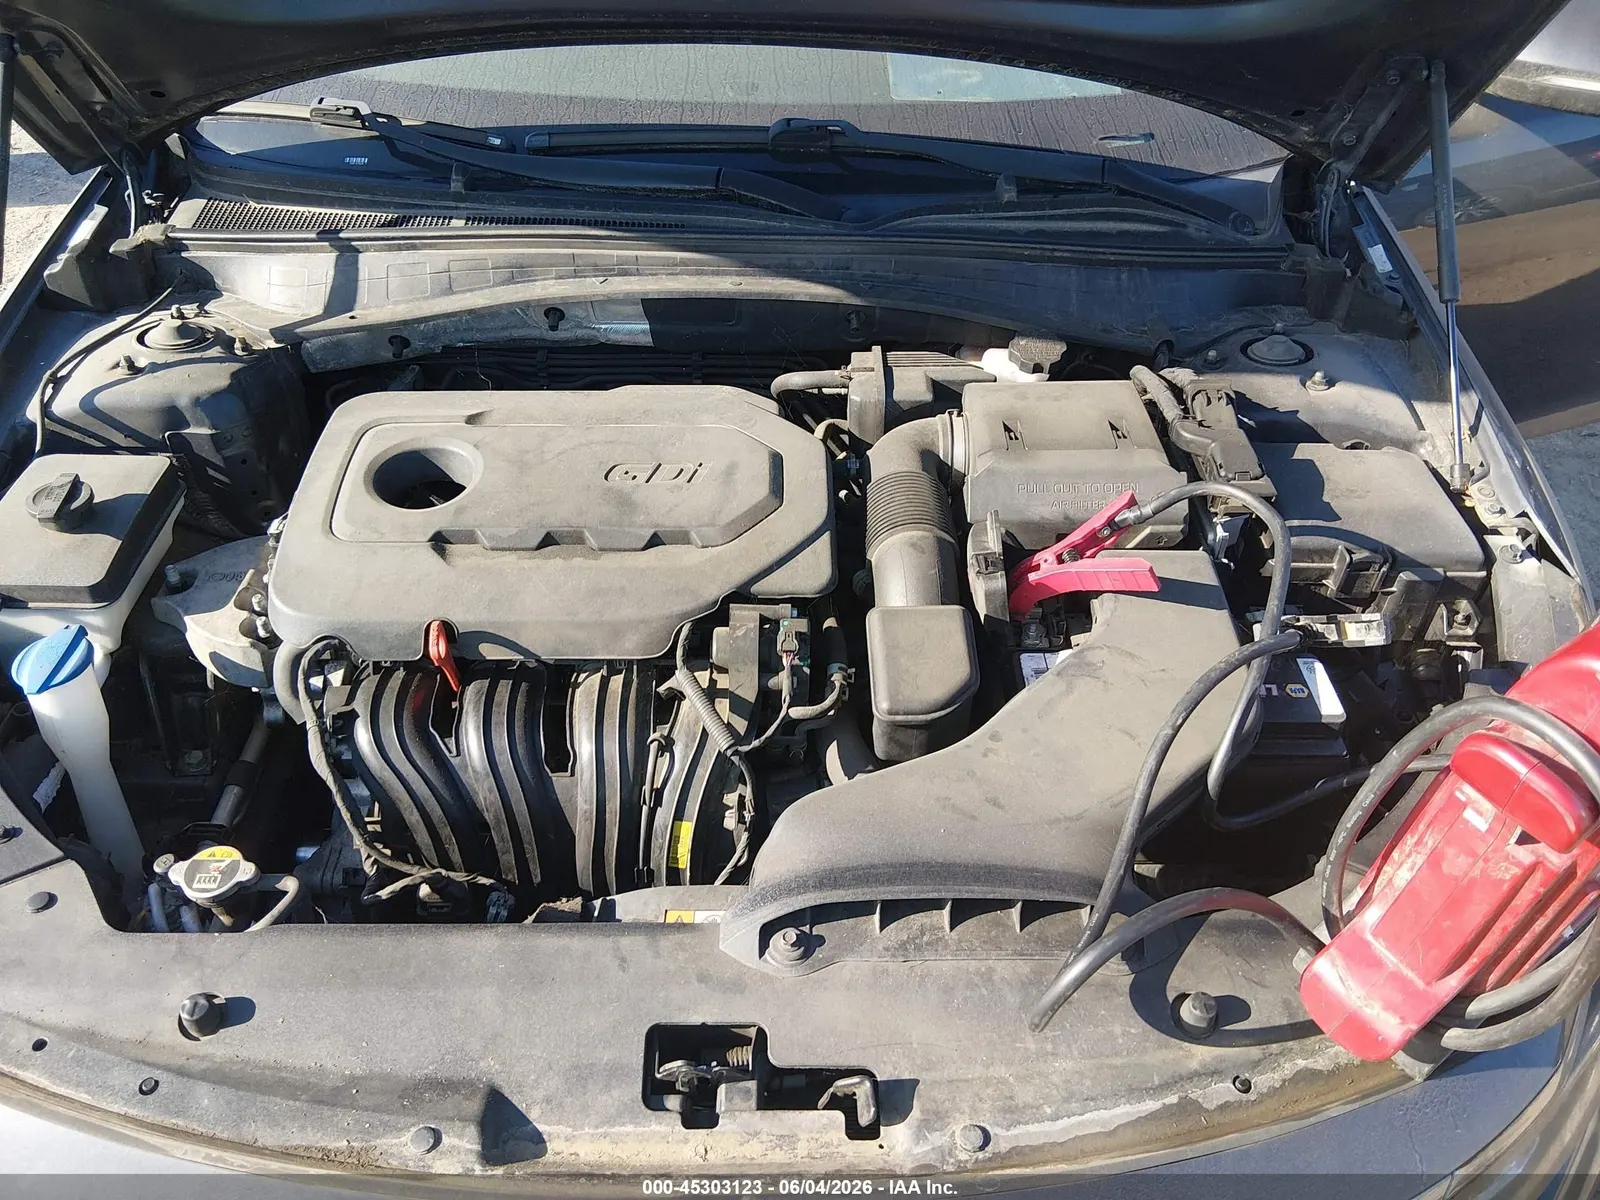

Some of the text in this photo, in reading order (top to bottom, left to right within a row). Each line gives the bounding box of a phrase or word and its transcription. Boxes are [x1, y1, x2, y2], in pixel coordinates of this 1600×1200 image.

[603, 461, 714, 484] GDi
[1017, 483, 1139, 494] PULL OUT TO OPEN
